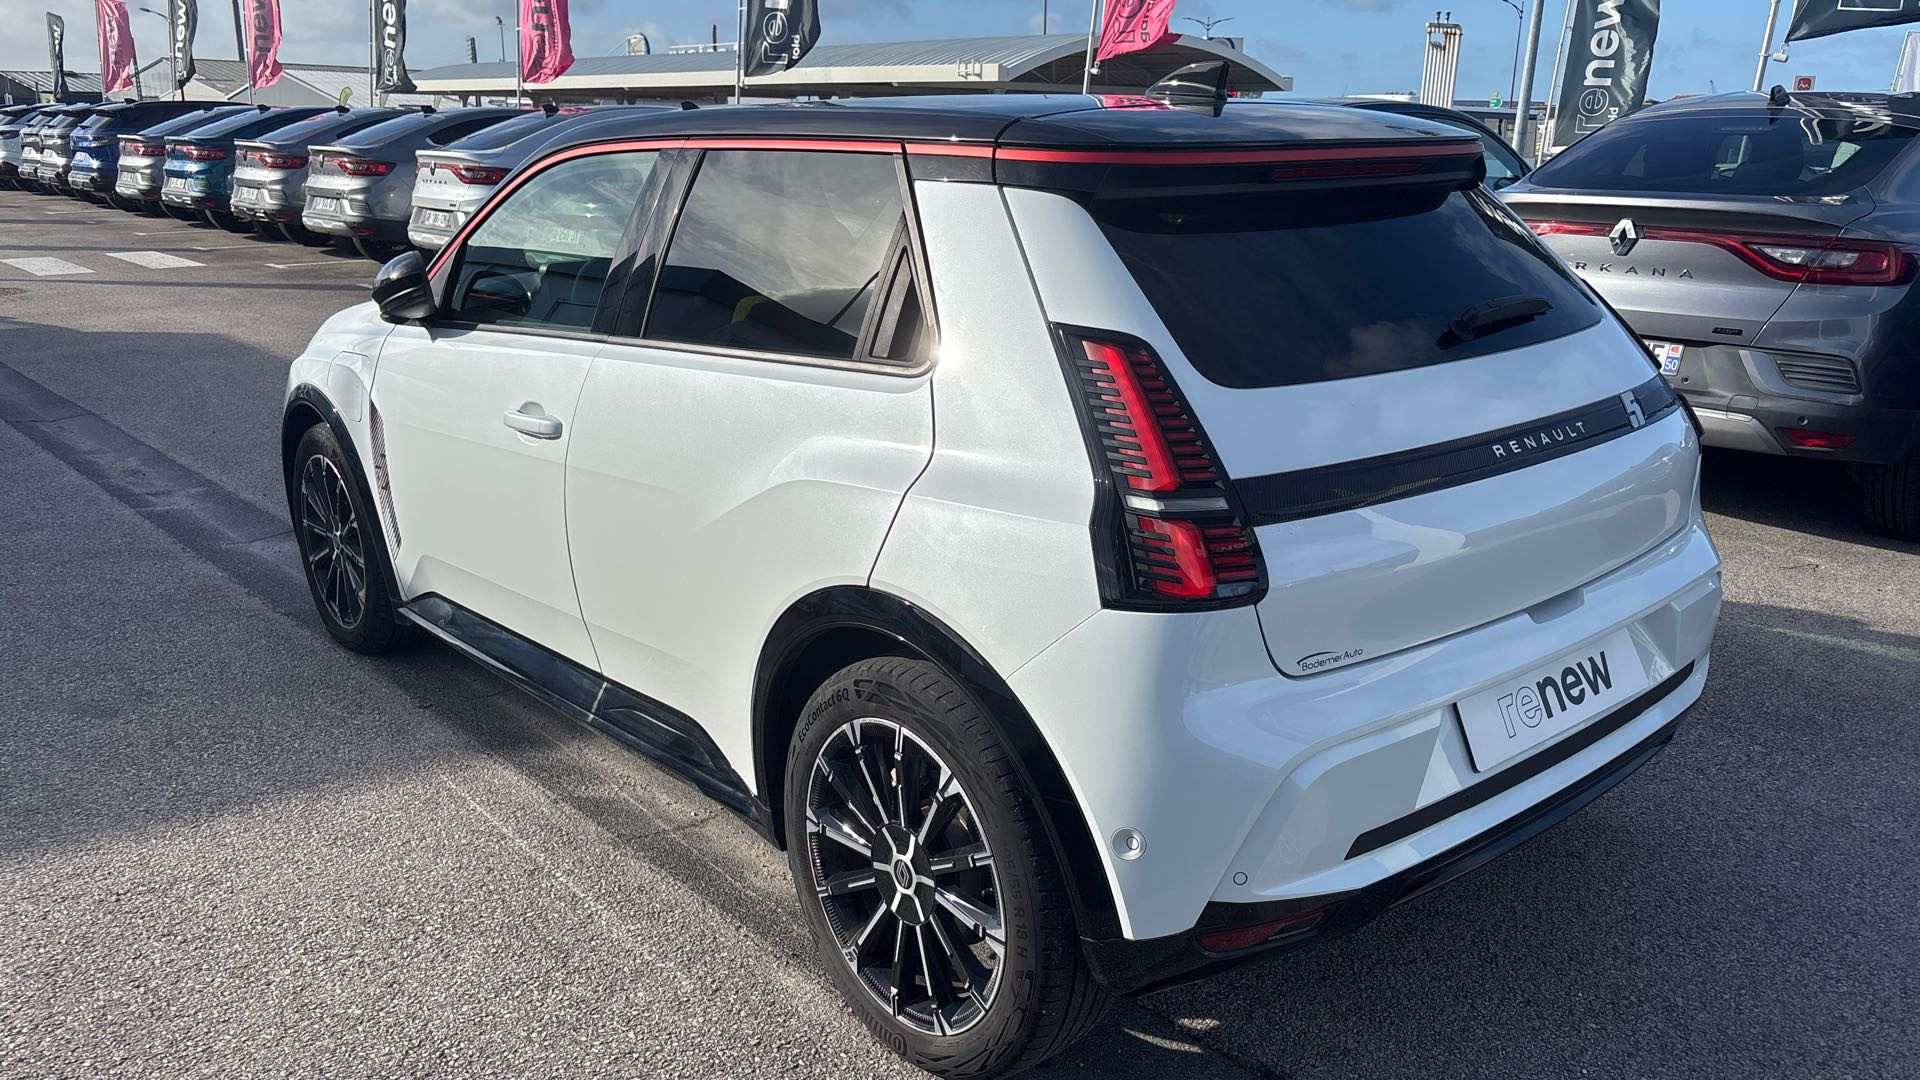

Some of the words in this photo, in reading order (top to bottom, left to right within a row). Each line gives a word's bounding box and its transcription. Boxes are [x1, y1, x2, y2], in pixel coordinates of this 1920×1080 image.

[382, 0, 397, 85] rene
[1575, 261, 1694, 279] RKANA
[1664, 359, 1678, 370] 50
[1492, 421, 1586, 458] RENAULT
[797, 693, 836, 744] EcoContact
[836, 687, 850, 704] 6Q
[1496, 651, 1613, 739] renew
